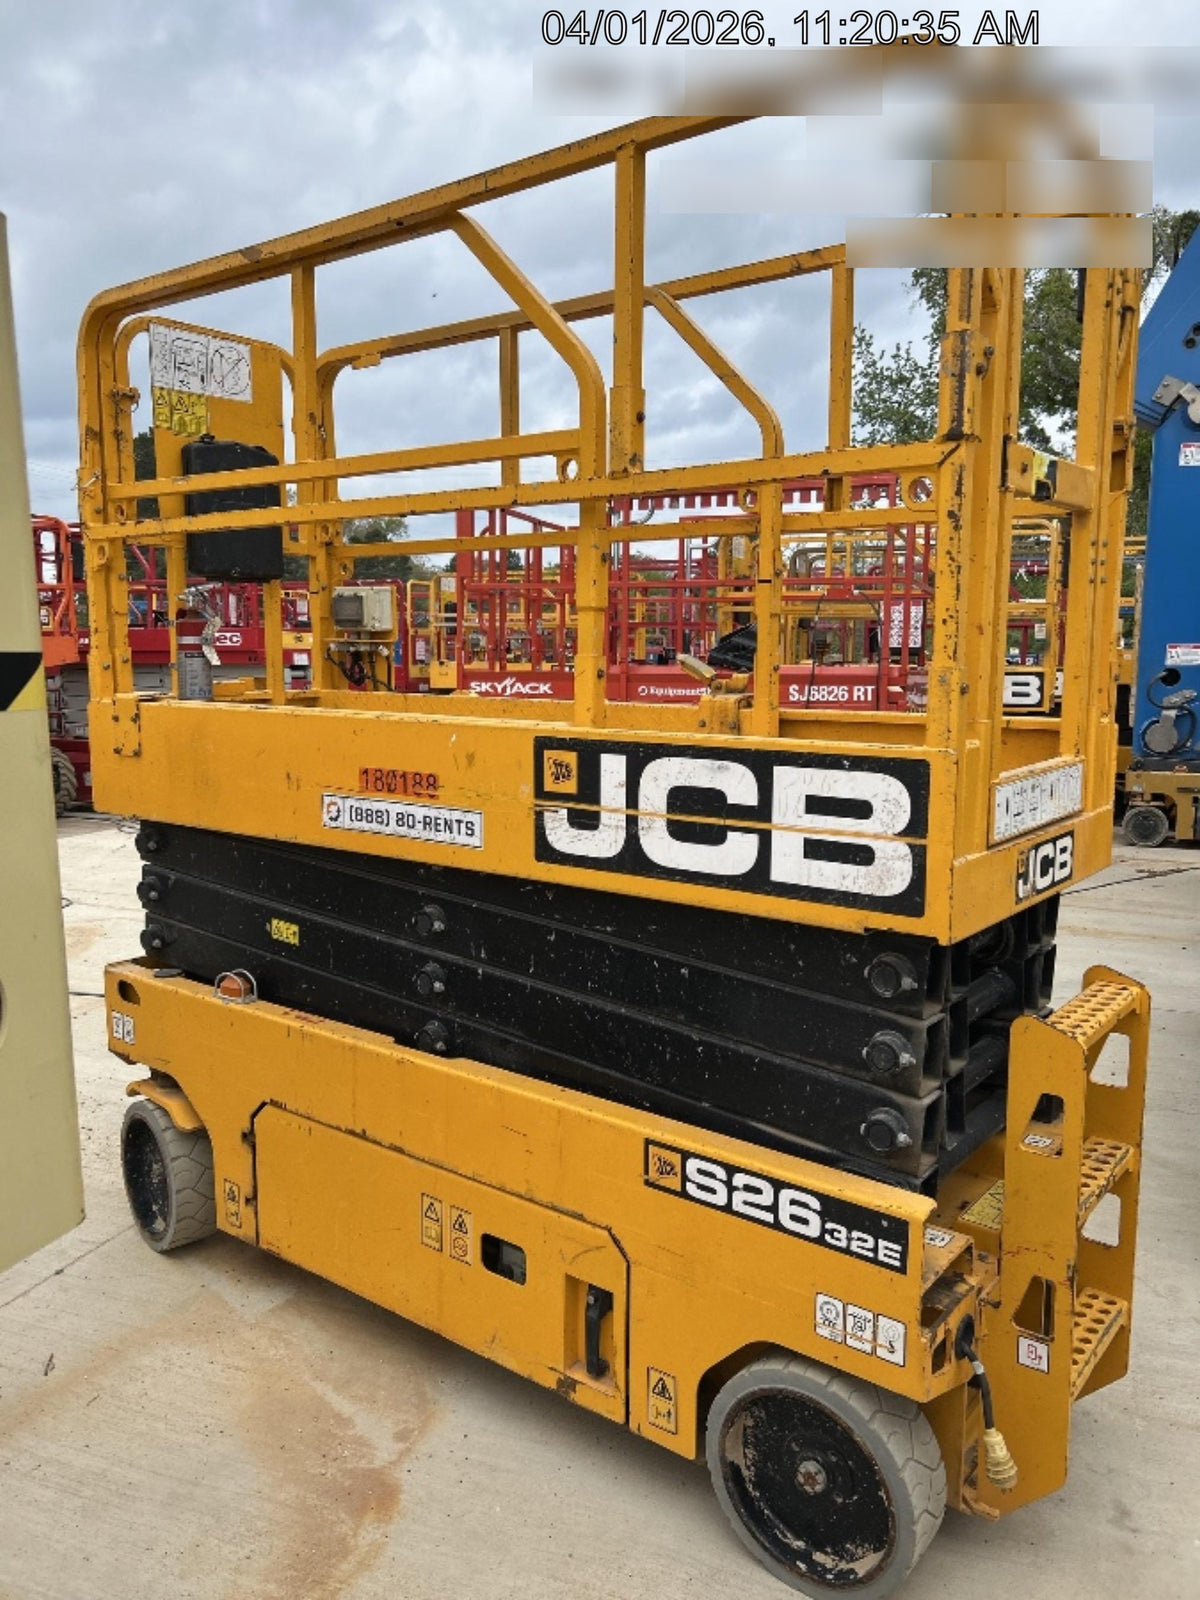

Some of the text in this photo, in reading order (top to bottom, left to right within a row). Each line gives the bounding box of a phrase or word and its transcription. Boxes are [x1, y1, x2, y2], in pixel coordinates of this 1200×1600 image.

[470, 677, 553, 696] SKYJACK
[789, 684, 876, 701] SJ6826 RT
[362, 768, 438, 798] 180188
[349, 805, 476, 837] (888) 80-RENTS
[544, 753, 913, 897] JCB
[1018, 835, 1073, 898] JCB
